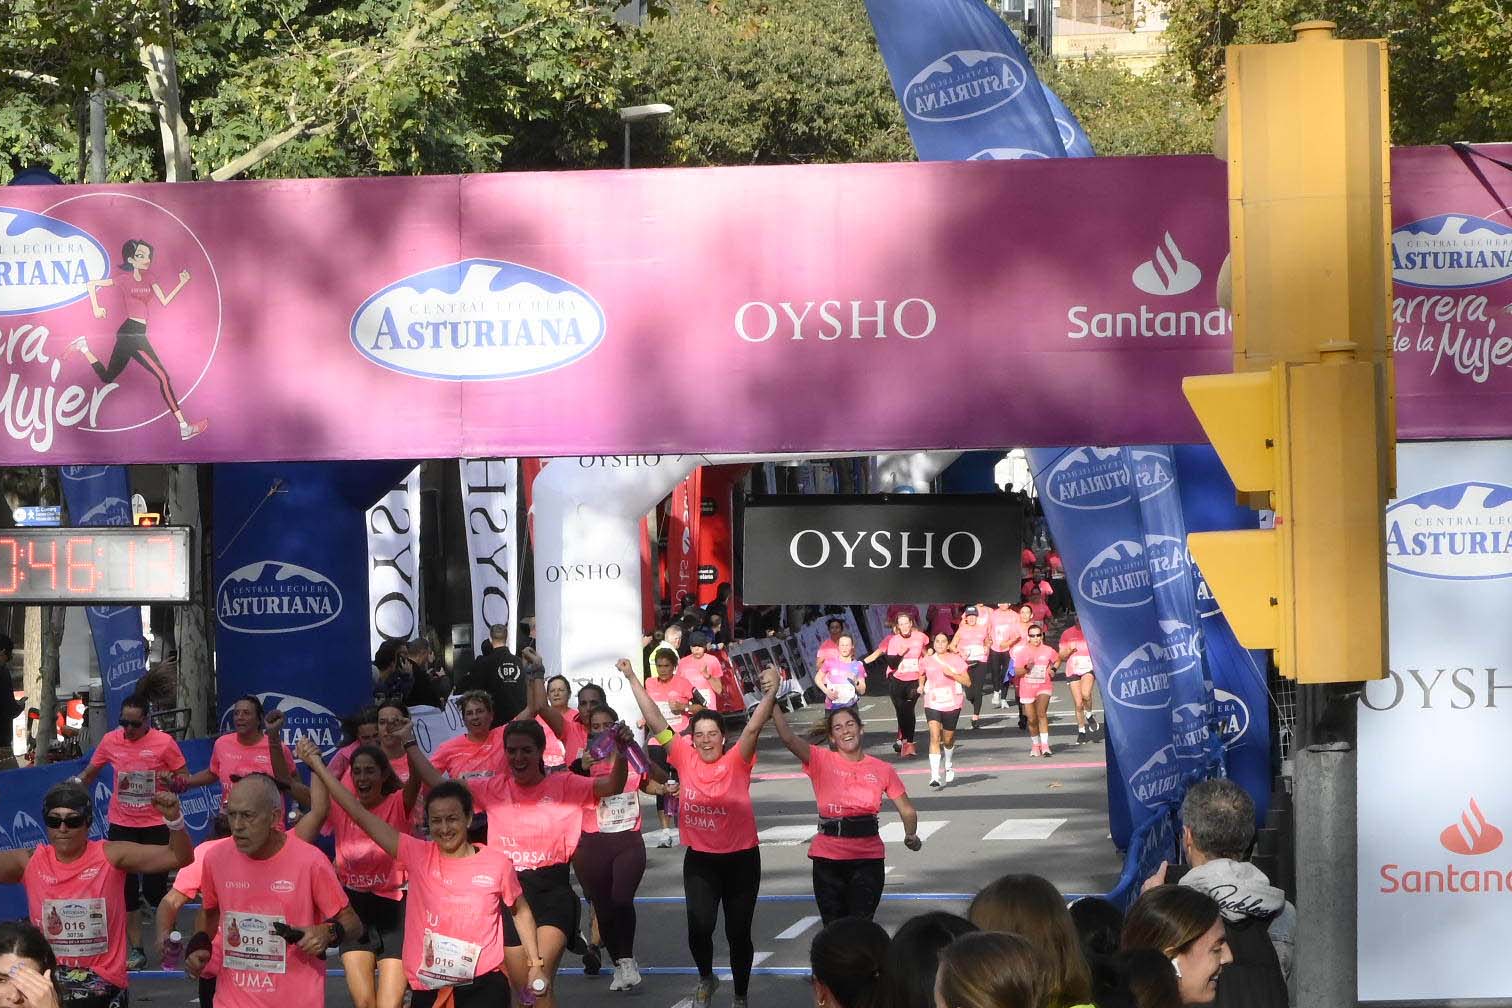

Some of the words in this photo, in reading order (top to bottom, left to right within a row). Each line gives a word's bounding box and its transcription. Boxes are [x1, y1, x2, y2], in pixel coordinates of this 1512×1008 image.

[13, 243, 84, 255] LECHERA
[1407, 239, 1457, 248] CENTRAL
[1464, 238, 1512, 246] LECHER
[1392, 295, 1488, 324] arrera
[734, 298, 937, 342] OYSHO
[1067, 304, 1232, 339] Santand
[370, 305, 586, 351] ASTURIANA
[1416, 324, 1435, 352] la
[1414, 516, 1482, 527] CENTRAL
[789, 529, 983, 571] OYSHO
[545, 562, 622, 583] OYSHO
[232, 586, 276, 594] CENTRAL
[280, 585, 329, 593] LECHERA
[220, 590, 333, 618] ASTURIANA
[287, 716, 329, 725] ECHERA
[685, 789, 697, 799] TU
[684, 803, 728, 816] DORSAL
[827, 803, 842, 814] TU
[684, 815, 716, 829] SUMA
[64, 921, 86, 931] 016
[241, 935, 264, 945] 016
[434, 957, 454, 968] 016
